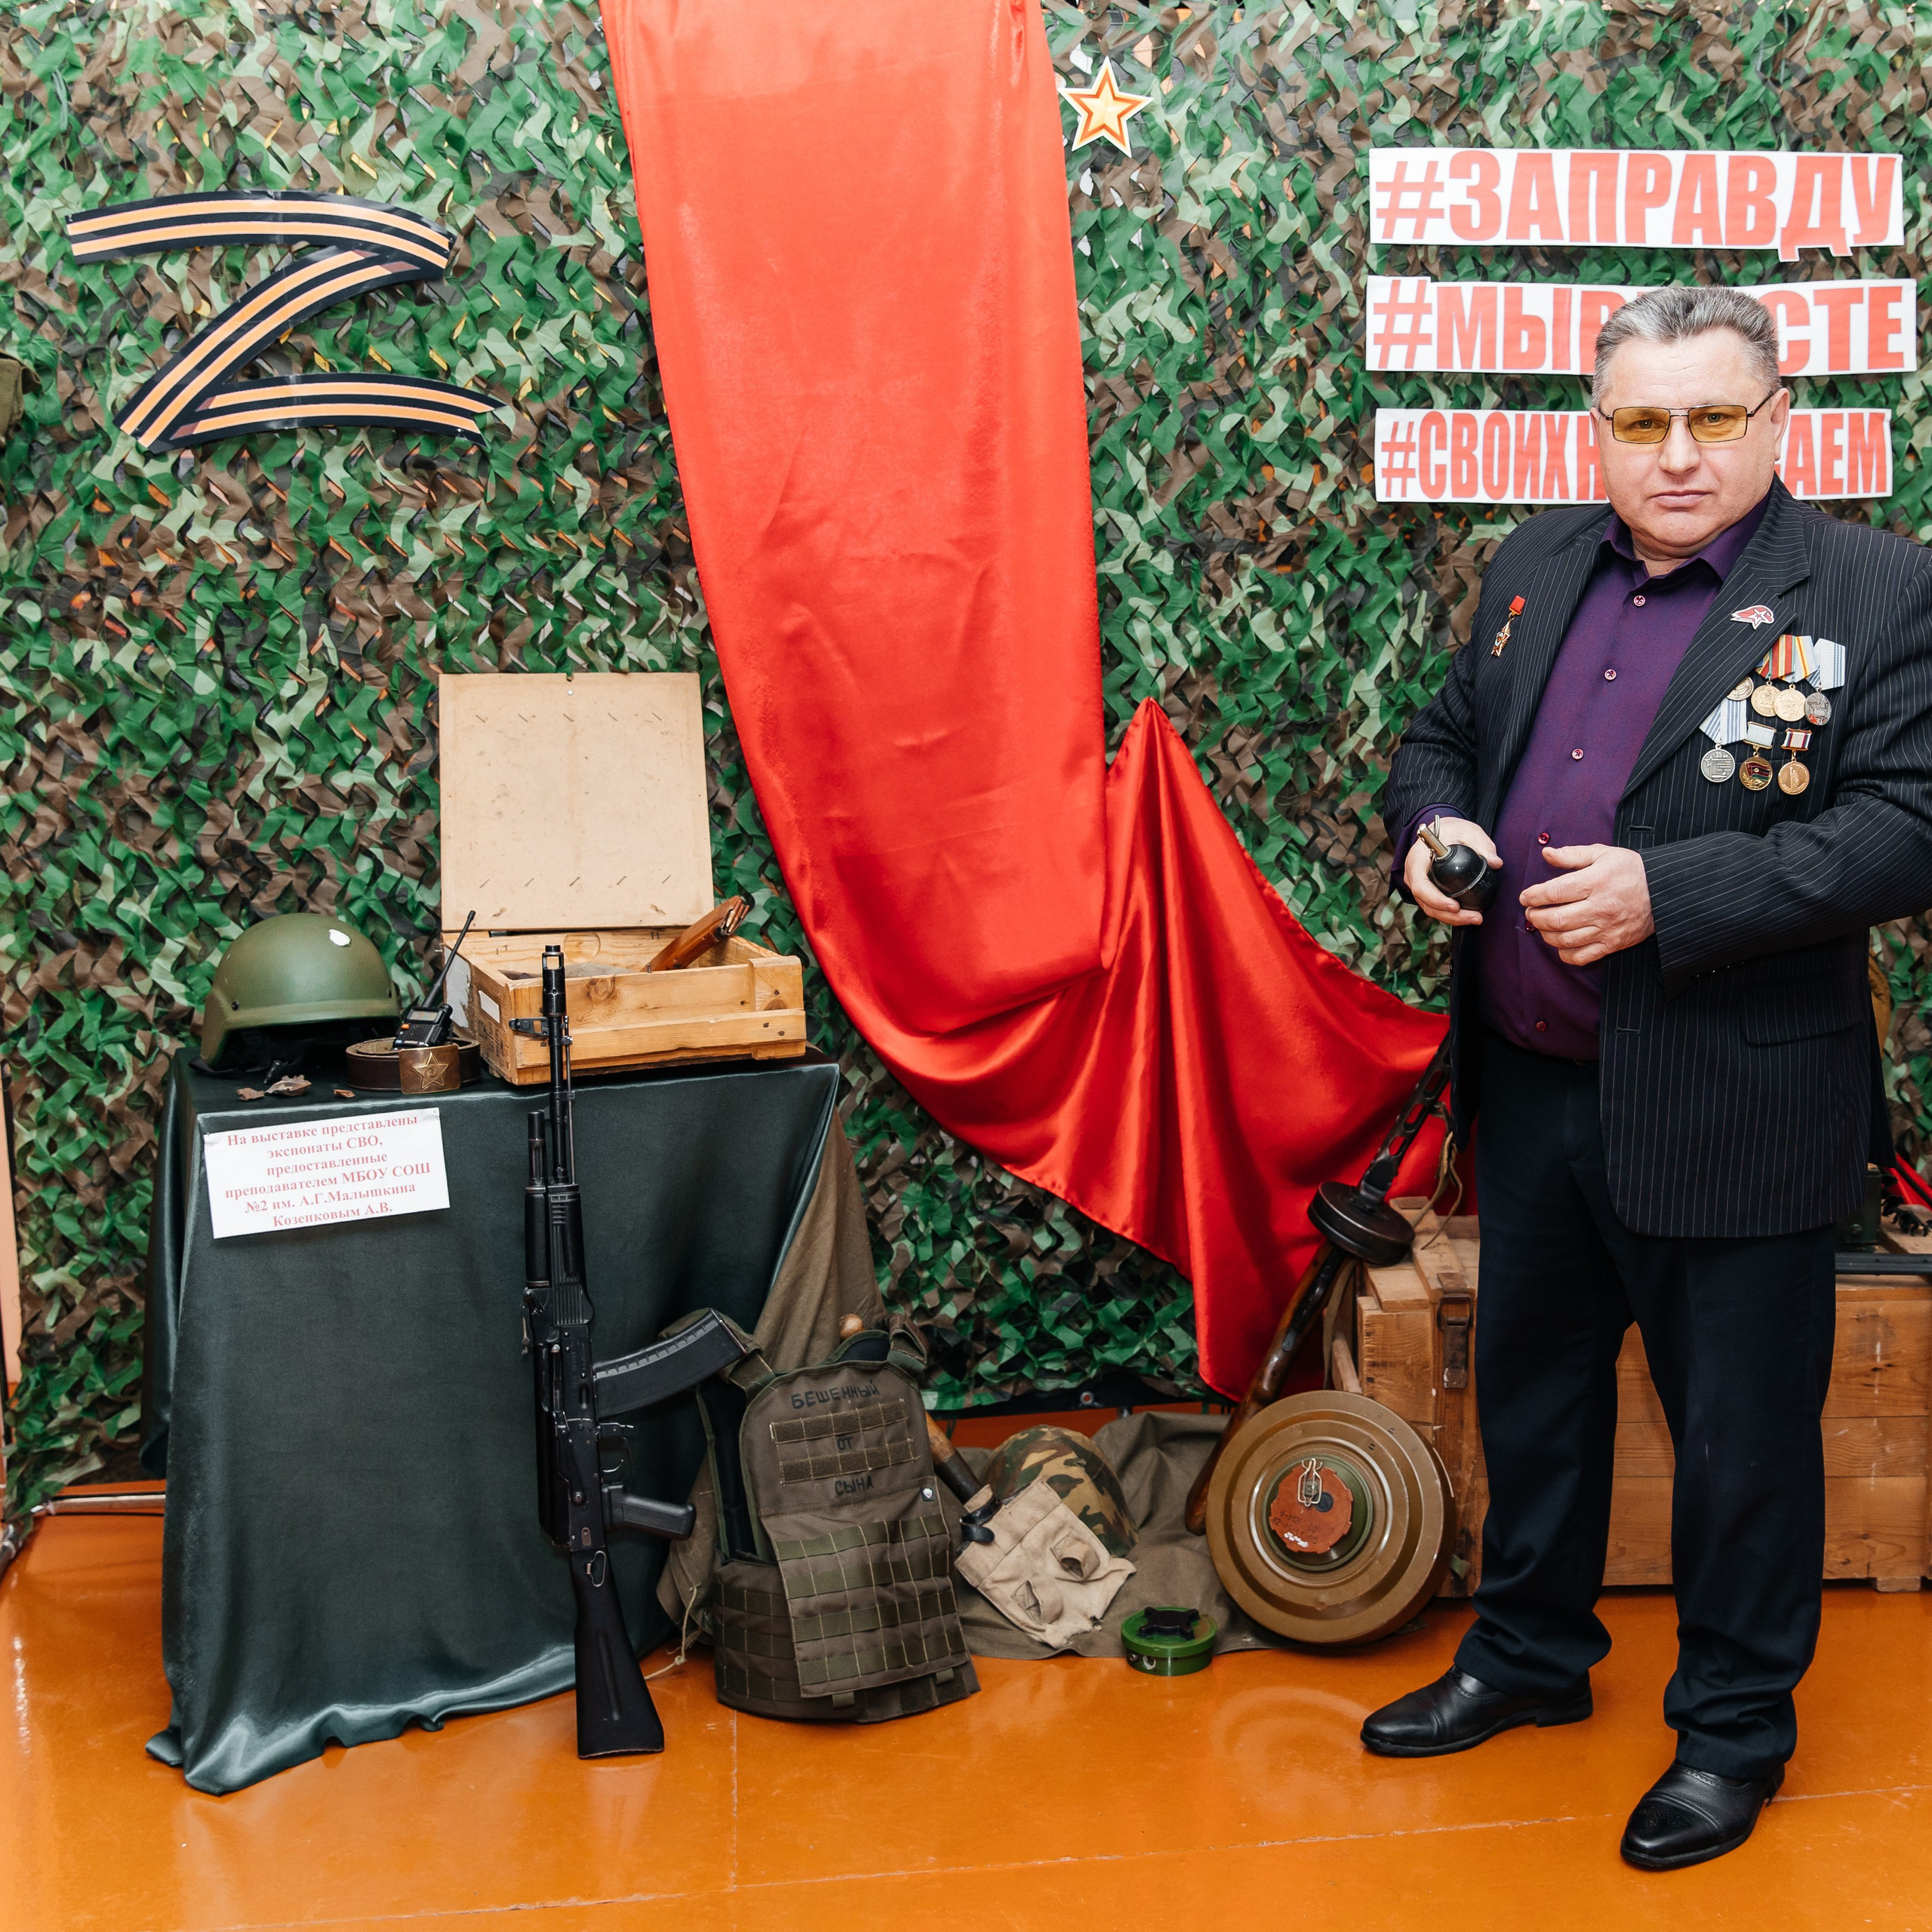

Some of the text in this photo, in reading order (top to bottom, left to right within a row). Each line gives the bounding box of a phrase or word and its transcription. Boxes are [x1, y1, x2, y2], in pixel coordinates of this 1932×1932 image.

[1376, 151, 1897, 260] #ЗАПРАВДУ
[1382, 411, 1887, 500] #СВОИХНАЕМ
[227, 1115, 418, 1147] На выставке представлены
[267, 1135, 383, 1159] экспонаты СВО,
[266, 1154, 387, 1178] предоставленные
[225, 1162, 431, 1201] преподавателем МБОУ СОШ
[245, 1183, 416, 1214] №2 им. А.Г.Малышкина
[273, 1201, 393, 1227] Козенковым А.В.
[791, 1380, 881, 1410] БЕШЕННЫЙ
[837, 1437, 854, 1451] ОТ
[835, 1475, 875, 1497] СЫНА
